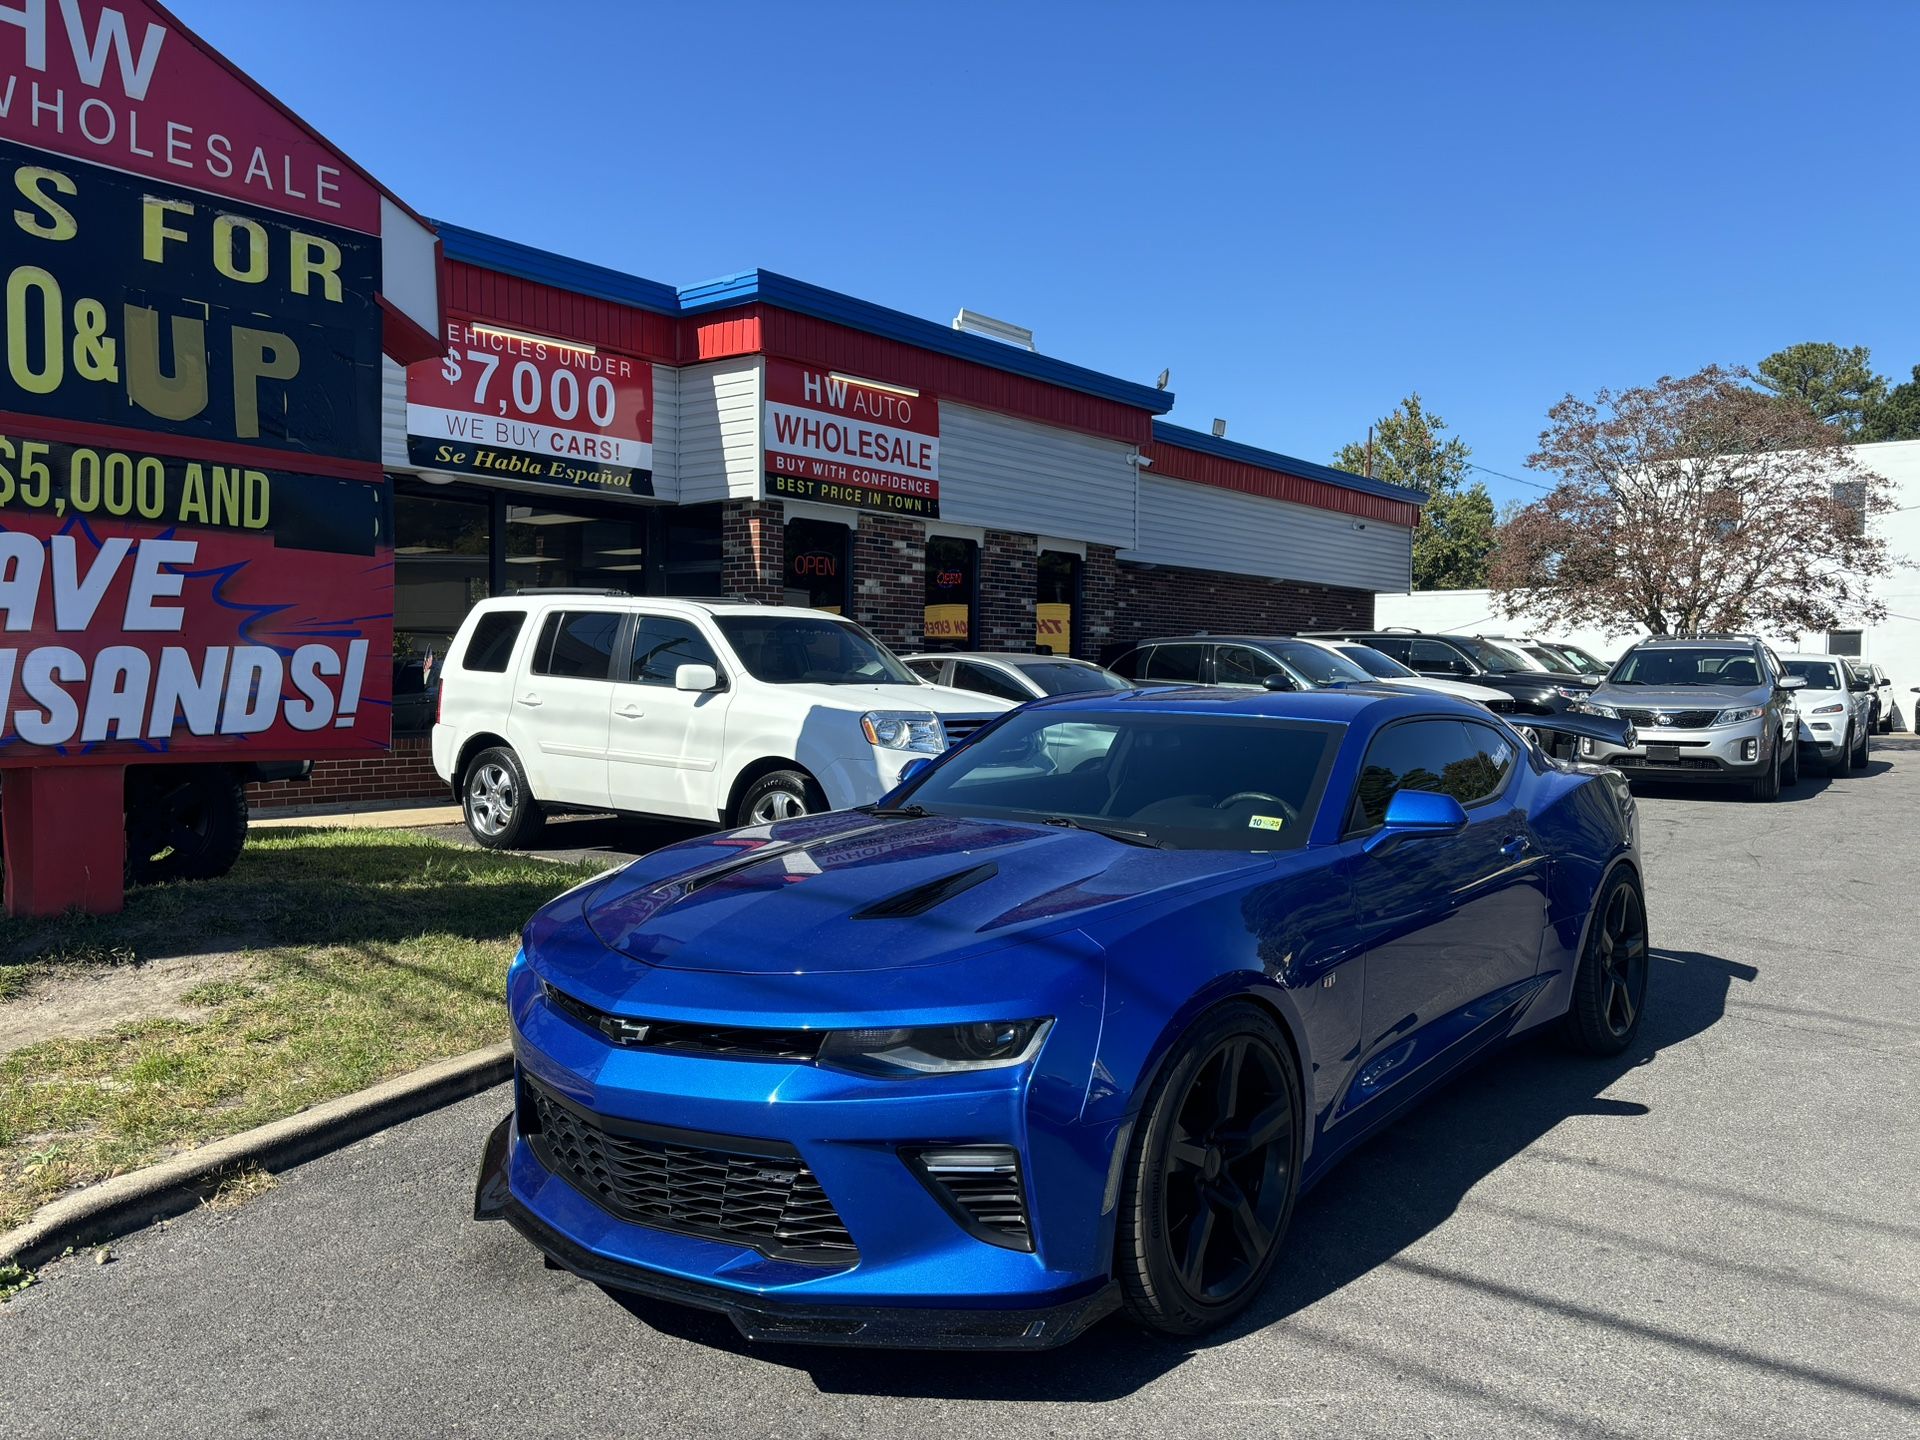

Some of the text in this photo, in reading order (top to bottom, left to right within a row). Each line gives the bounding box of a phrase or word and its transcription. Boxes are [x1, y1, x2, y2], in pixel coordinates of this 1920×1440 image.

[13, 166, 343, 303] S FOR
[559, 346, 632, 378] UNDER
[441, 346, 616, 427] $7,000
[803, 371, 912, 424] HW AUTO
[446, 414, 621, 461] WE BUY CARS!
[773, 412, 932, 471] WHOLESALE
[434, 445, 633, 488] Se Habla Español
[776, 456, 931, 494] BUY WITH CONFIDENCE
[178, 462, 270, 529] AND
[776, 477, 815, 495] BEST
[821, 484, 862, 502] PRICE
[868, 491, 882, 505] IN
[888, 495, 922, 511] TOWN
[794, 555, 836, 577] OPEN
[1253, 818, 1262, 826] 10
